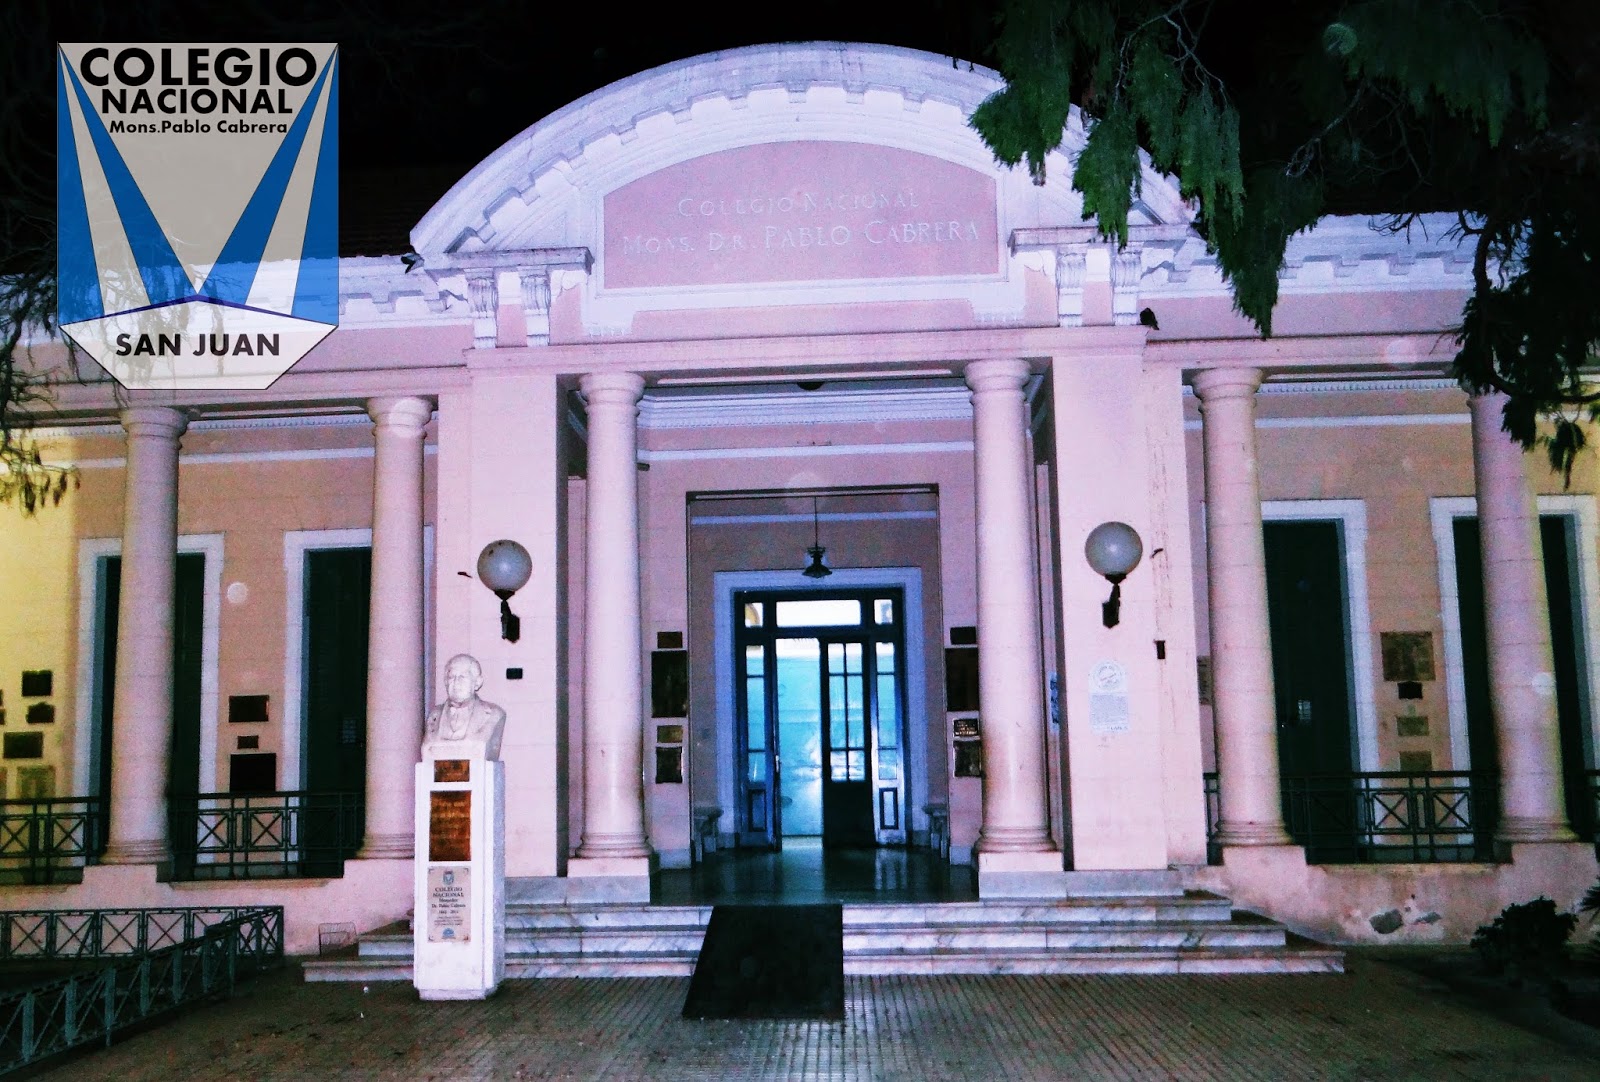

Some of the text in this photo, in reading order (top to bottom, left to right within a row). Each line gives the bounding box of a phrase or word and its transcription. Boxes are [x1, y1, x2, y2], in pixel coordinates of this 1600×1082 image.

[678, 192, 920, 217] COLEGIO NACIONAL
[765, 225, 850, 249] PABLO
[864, 220, 979, 244] CABRERA
